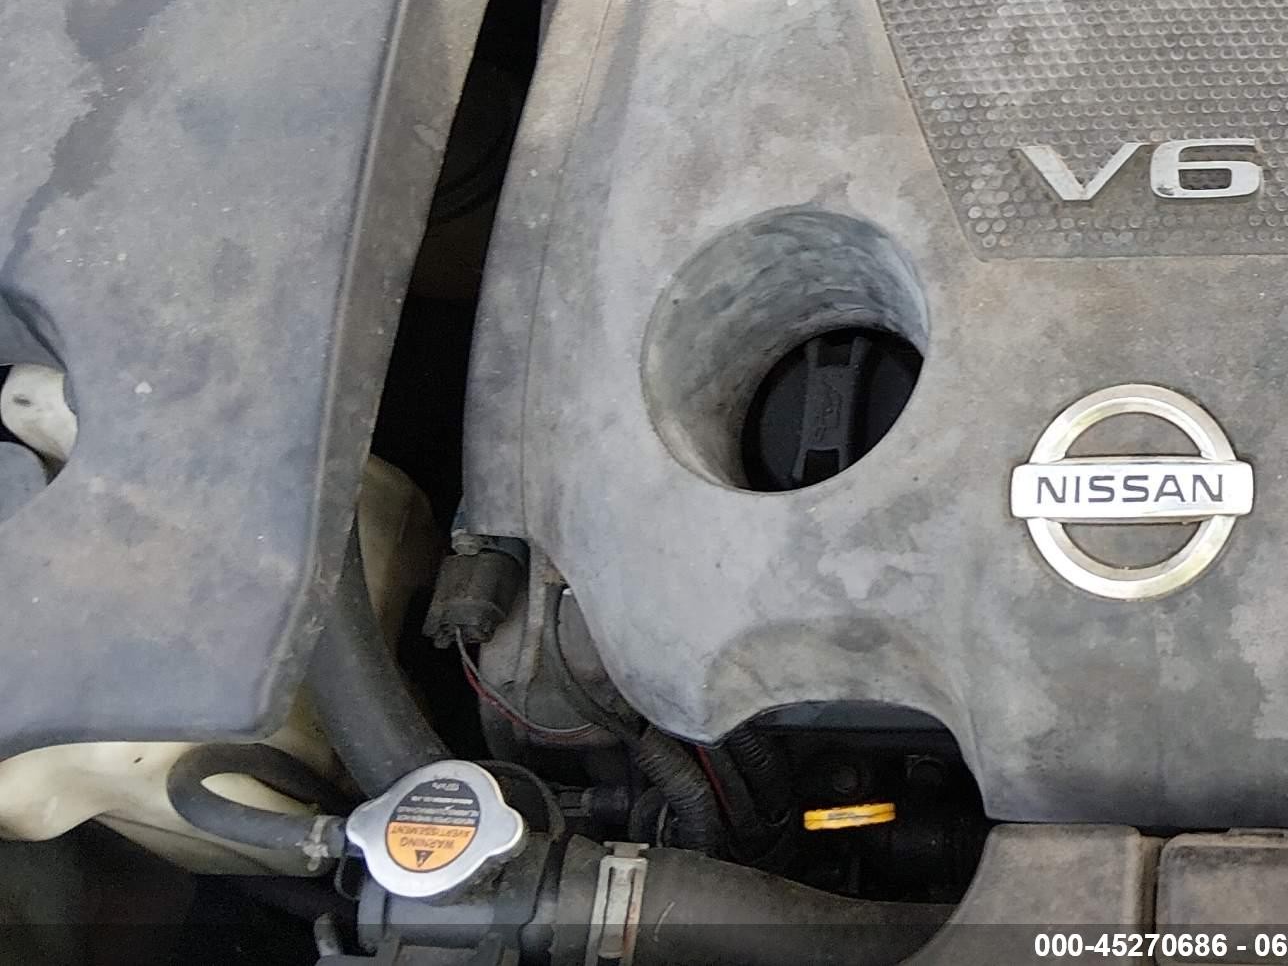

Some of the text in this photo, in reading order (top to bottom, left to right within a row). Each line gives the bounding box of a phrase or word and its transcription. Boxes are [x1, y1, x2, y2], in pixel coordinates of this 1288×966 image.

[1020, 138, 1263, 201] V6
[1037, 474, 1223, 504] NISSAN
[400, 837, 454, 850] WARNING
